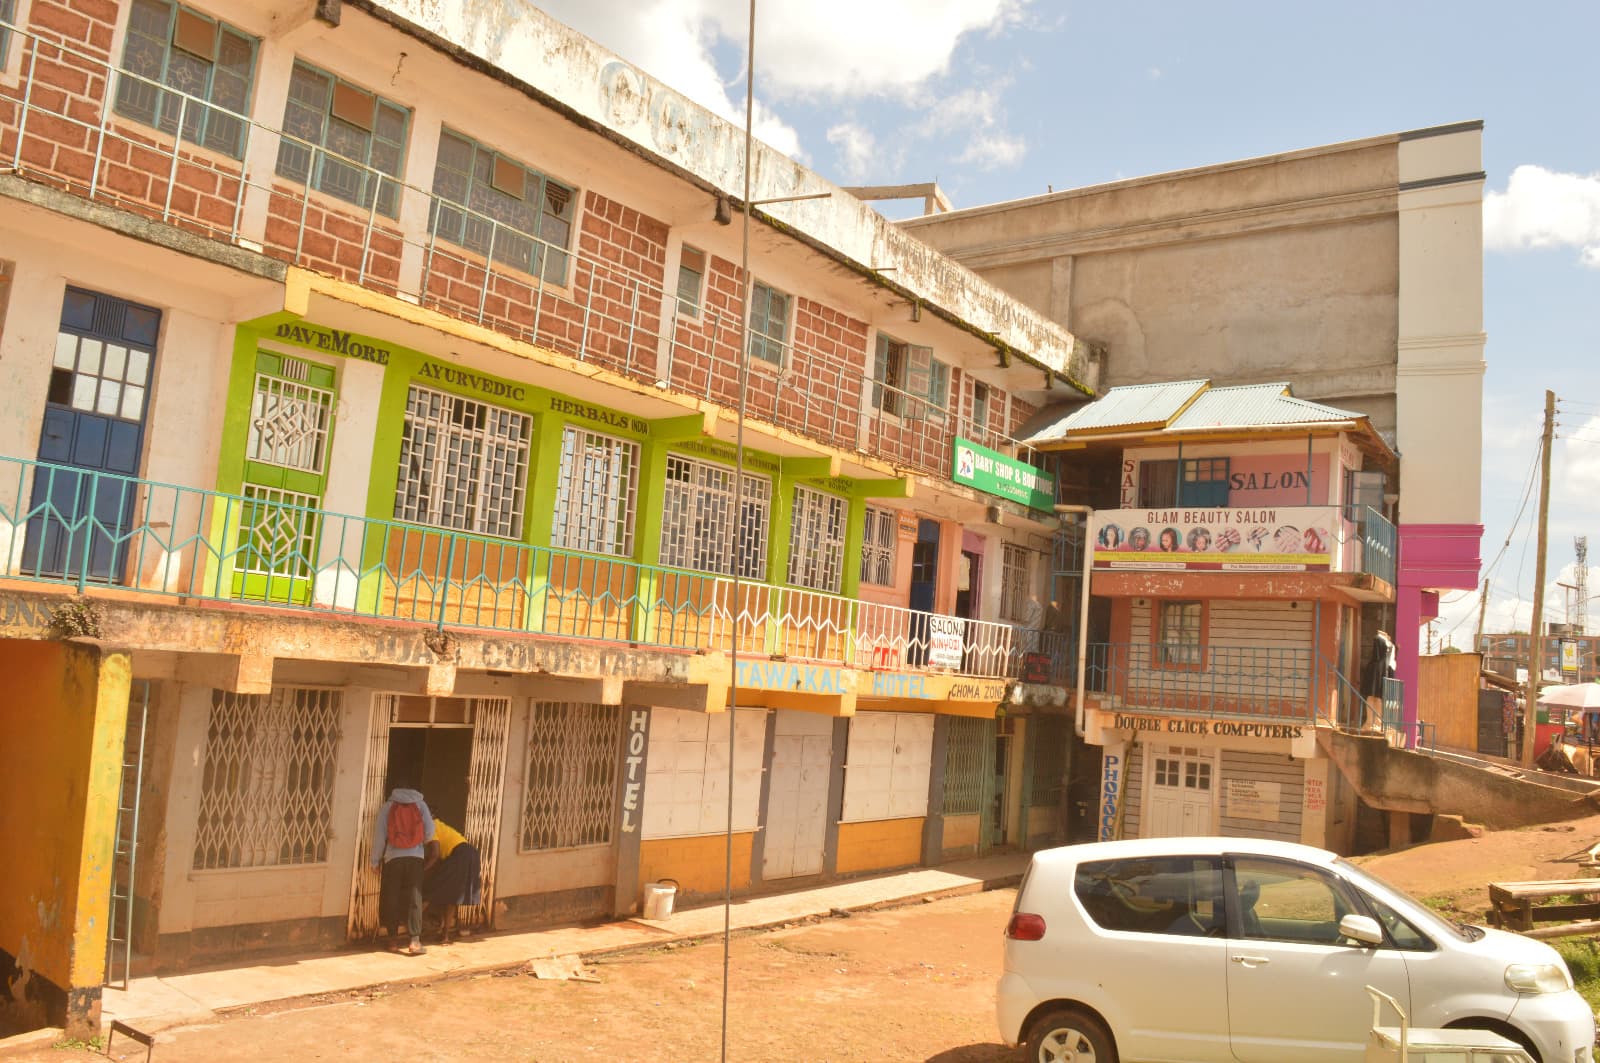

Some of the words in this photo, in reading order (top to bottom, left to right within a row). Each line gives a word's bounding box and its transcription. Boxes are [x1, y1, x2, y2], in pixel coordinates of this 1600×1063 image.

[418, 362, 525, 401] AYURVEDIC
[550, 397, 628, 429] HERBALS
[975, 453, 994, 474] BABY
[995, 461, 1013, 480] SHOP
[1015, 469, 1021, 484] &
[1229, 471, 1315, 491] SALON
[1147, 511, 1179, 524] GLAM
[1184, 510, 1231, 524] BEAUTY
[1236, 510, 1277, 524] SALON
[931, 618, 959, 636] SALON
[931, 637, 960, 651] KINYOZI
[736, 660, 848, 695] TAWAKAL
[873, 672, 929, 699] HOTEL
[951, 683, 980, 699] CHOMA
[984, 685, 1004, 699] ZONE
[1114, 713, 1161, 732] DOUBLE
[1168, 719, 1209, 734] CLICK
[621, 711, 648, 833] HOTEL
[1101, 755, 1118, 843] PHOTOCO
